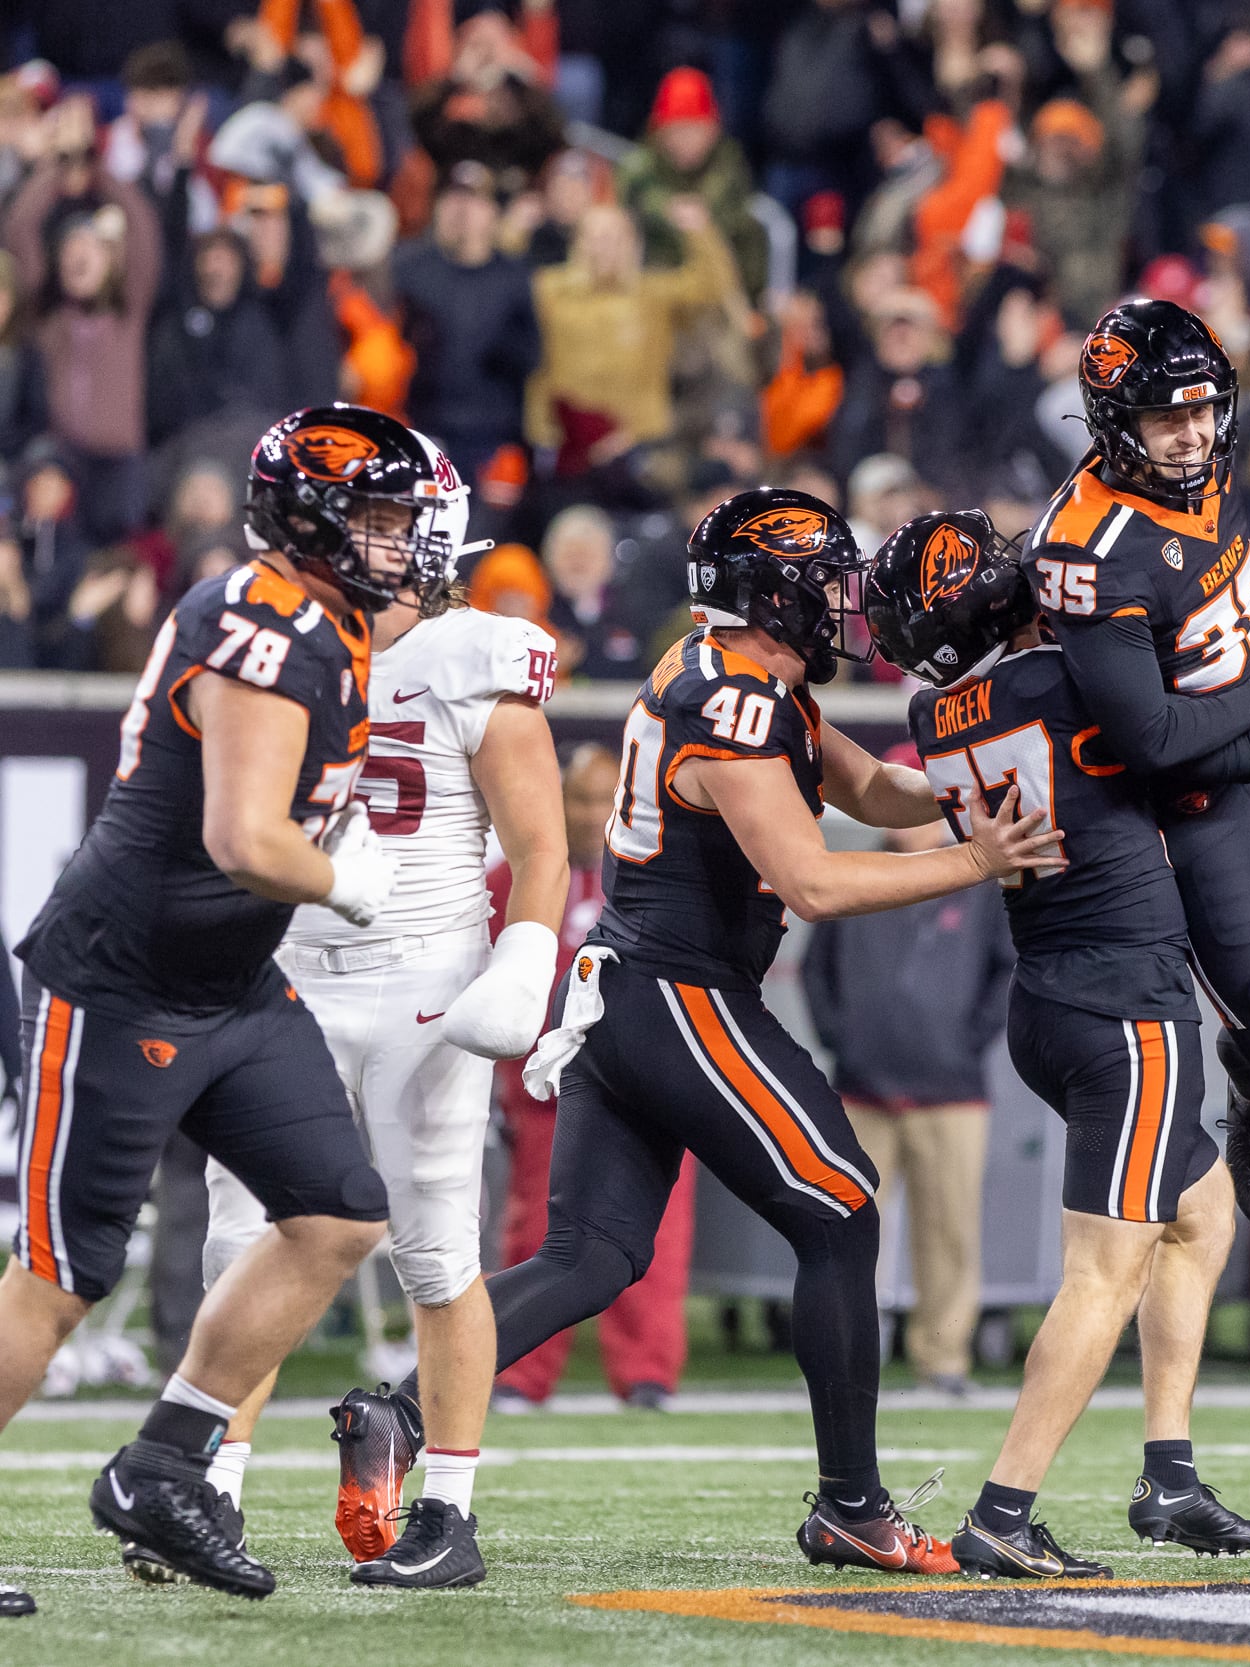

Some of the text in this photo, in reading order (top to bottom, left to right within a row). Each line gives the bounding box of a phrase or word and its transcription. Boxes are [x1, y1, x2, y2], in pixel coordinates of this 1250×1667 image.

[1183, 385, 1208, 401] OSU
[688, 562, 699, 593] 0
[1036, 557, 1097, 616] 35
[1199, 534, 1244, 598] BEAVS
[206, 611, 292, 688] 78
[526, 648, 558, 703] 95
[914, 660, 943, 680] 7
[702, 686, 775, 748] 40
[934, 679, 993, 739] GREEN
[352, 721, 427, 836] 5
[605, 700, 666, 865] 0
